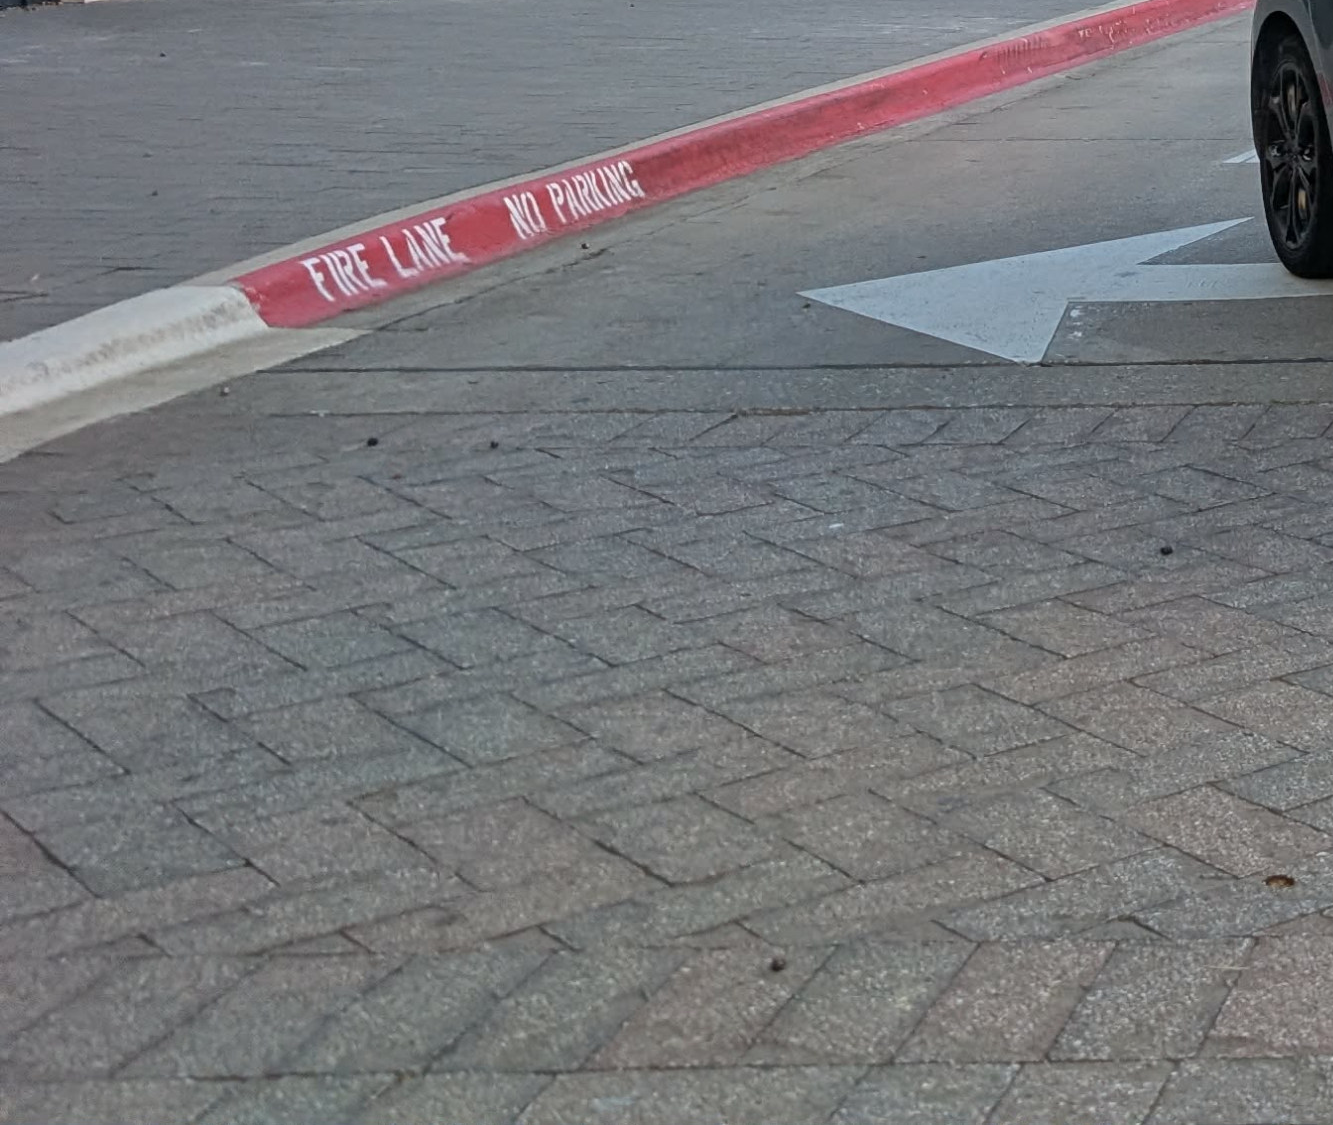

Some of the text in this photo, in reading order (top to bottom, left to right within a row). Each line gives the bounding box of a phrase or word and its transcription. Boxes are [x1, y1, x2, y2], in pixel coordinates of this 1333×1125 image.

[301, 160, 645, 302] FIRE LANE NO PARKING
